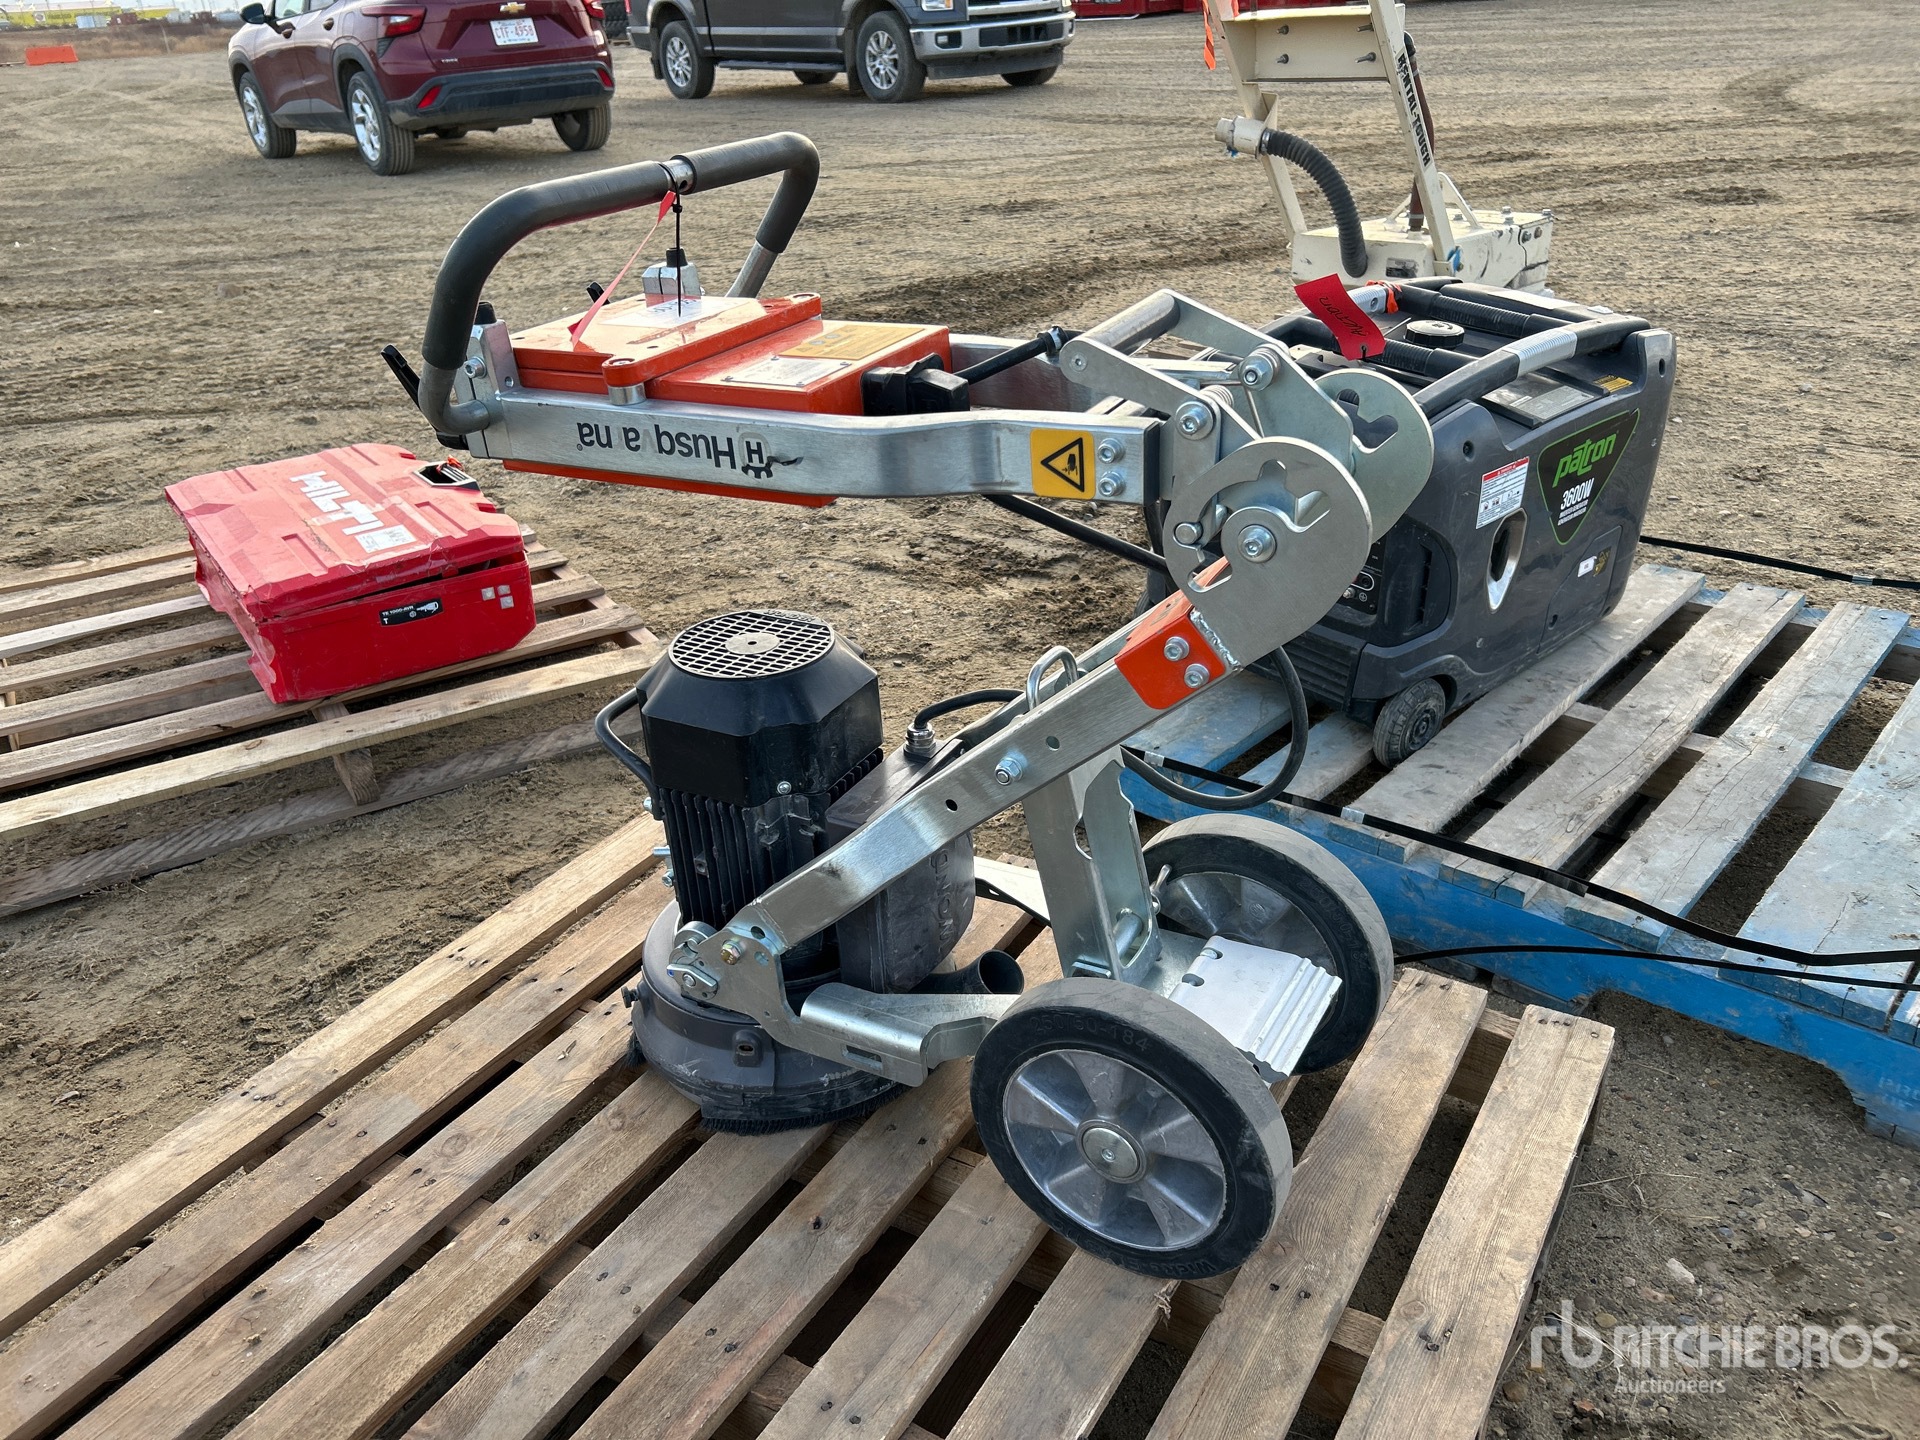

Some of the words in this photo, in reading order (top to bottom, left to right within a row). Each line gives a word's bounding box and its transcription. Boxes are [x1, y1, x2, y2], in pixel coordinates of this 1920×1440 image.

[577, 421, 737, 470] Husqana
[1552, 433, 1617, 488] patron
[289, 470, 384, 536] HILTI
[1560, 478, 1595, 510] 3600W
